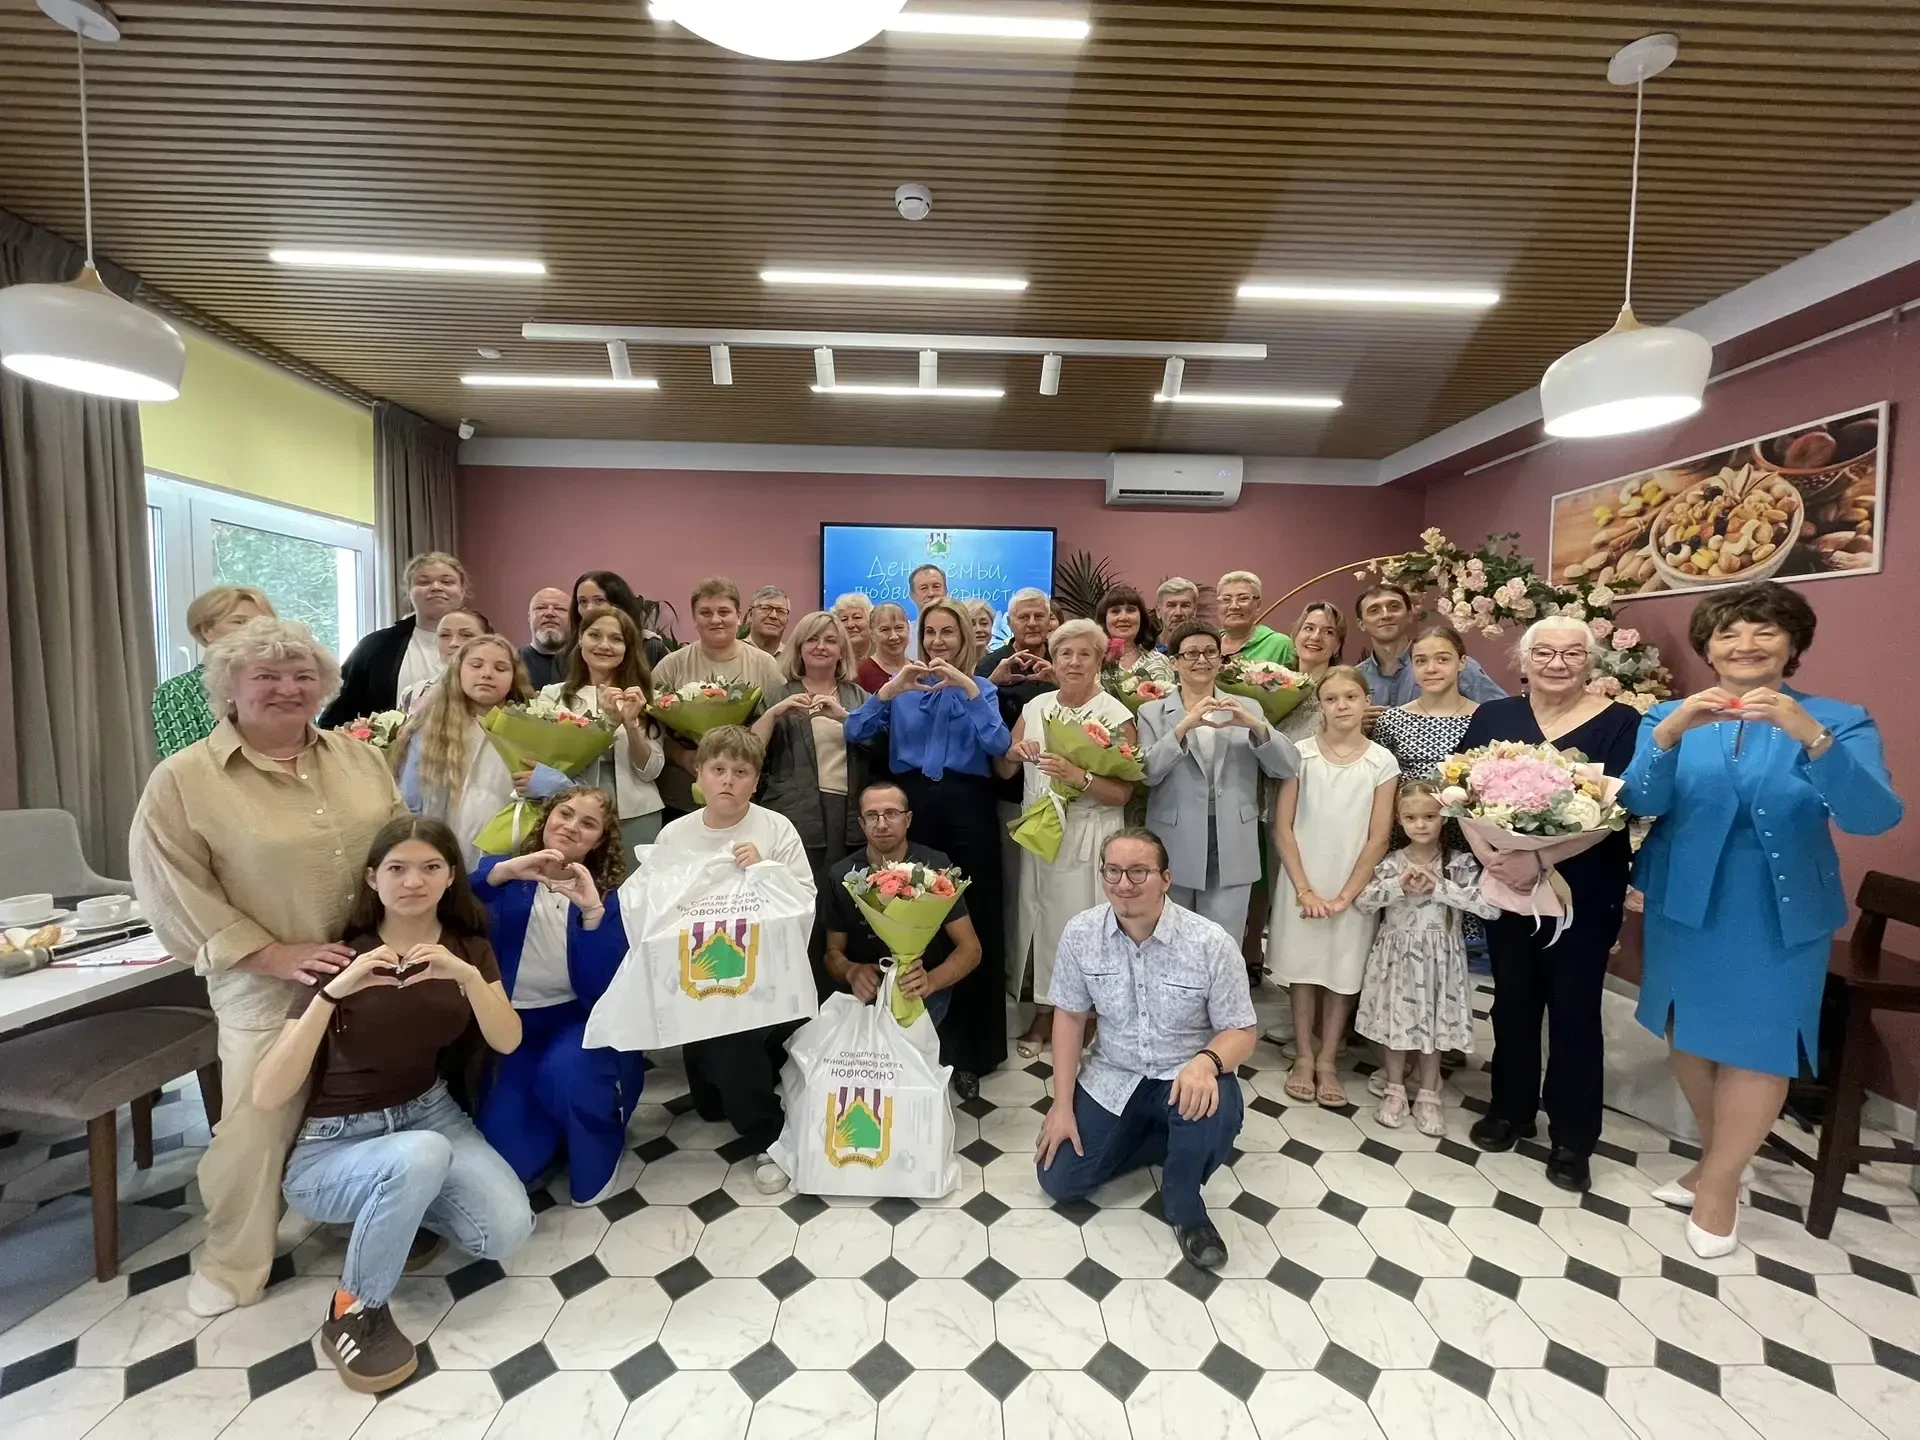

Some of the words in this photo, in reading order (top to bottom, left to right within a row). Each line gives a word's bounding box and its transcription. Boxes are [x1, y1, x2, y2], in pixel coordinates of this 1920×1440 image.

[866, 555, 912, 585] Ден
[946, 560, 1007, 582] емьи,
[949, 586, 1015, 601] ерност
